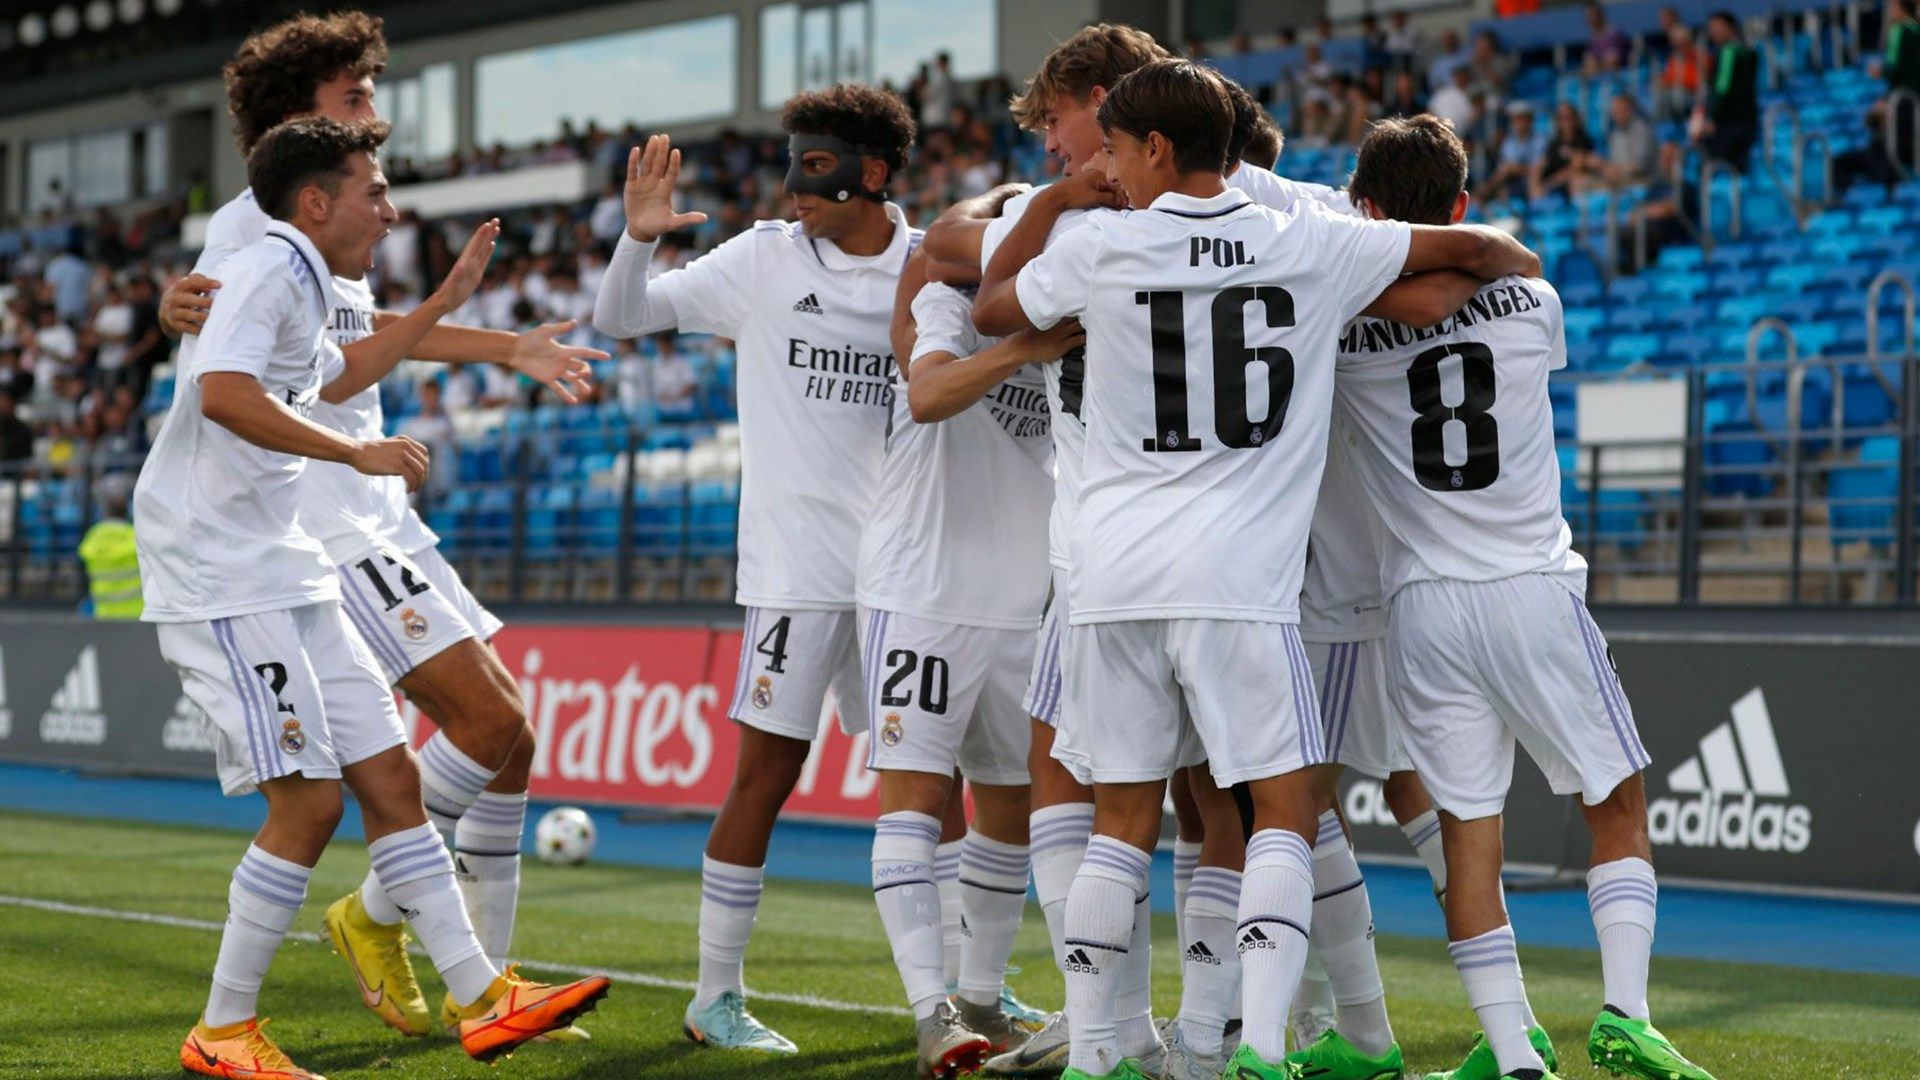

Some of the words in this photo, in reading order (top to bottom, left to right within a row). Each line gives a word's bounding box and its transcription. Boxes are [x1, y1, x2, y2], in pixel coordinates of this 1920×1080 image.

[1190, 236, 1255, 268] POL
[793, 304, 823, 315] adidas
[788, 337, 896, 379] Emirat
[1135, 286, 1296, 452] 16
[805, 375, 836, 401] FLY
[840, 380, 889, 407] BETTE
[1406, 341, 1500, 492] 8
[355, 555, 430, 611] 12
[756, 615, 791, 674] 4
[253, 661, 296, 715] 2
[881, 649, 949, 715] 20
[519, 646, 720, 788] irates
[1647, 788, 1812, 853] adidas
